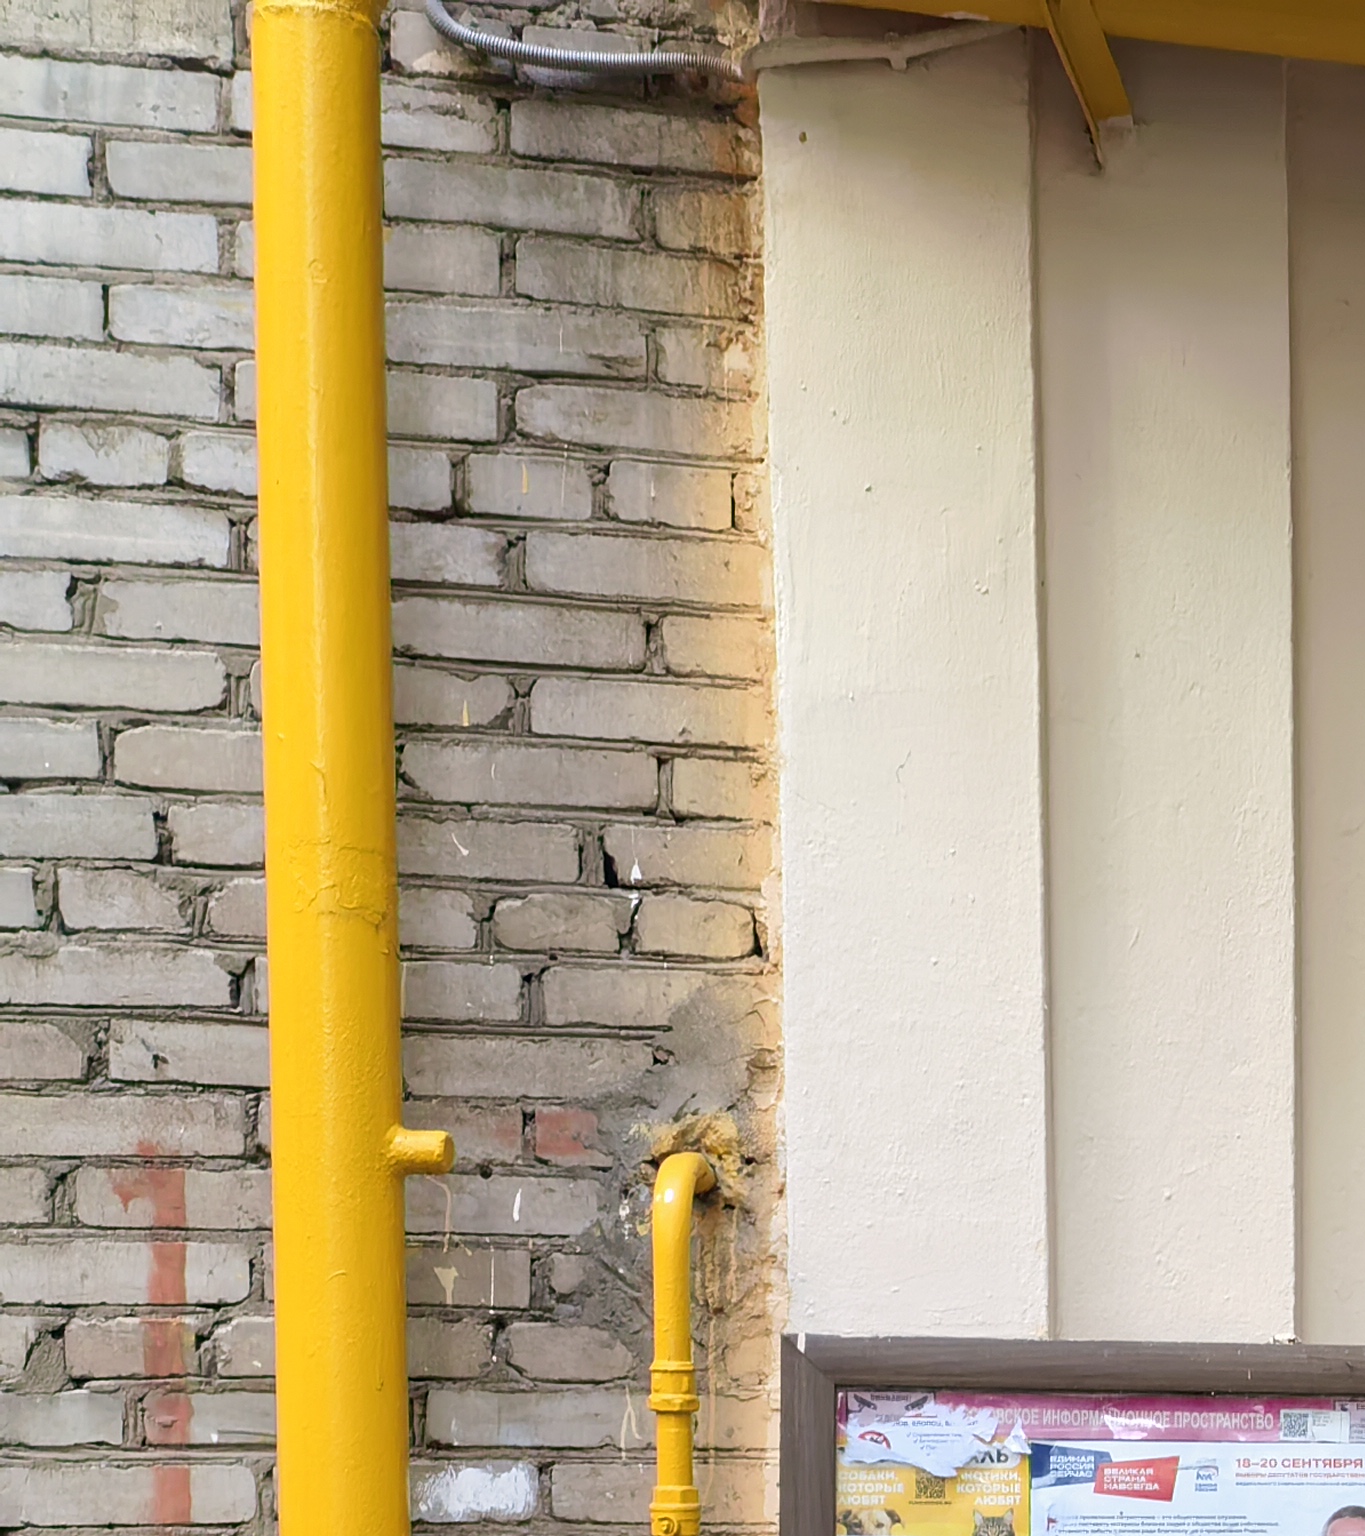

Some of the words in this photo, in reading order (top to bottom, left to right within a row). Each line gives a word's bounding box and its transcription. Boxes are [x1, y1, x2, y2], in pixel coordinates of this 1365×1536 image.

[1174, 1410, 1273, 1429] ПРОСТРАНСТВО
[1281, 1458, 1363, 1469] СЕНТЯБРЯ
[1050, 1470, 1093, 1478] СЕЙЧАС
[838, 1483, 903, 1494] КОТОРЫЕ
[957, 1483, 1021, 1494] КОТОРЫЕ
[1104, 1483, 1160, 1491] НАВСЕГДА
[838, 1495, 886, 1505] ЛЮБЯТ
[974, 1495, 1021, 1505] ЛЮБЯТ
